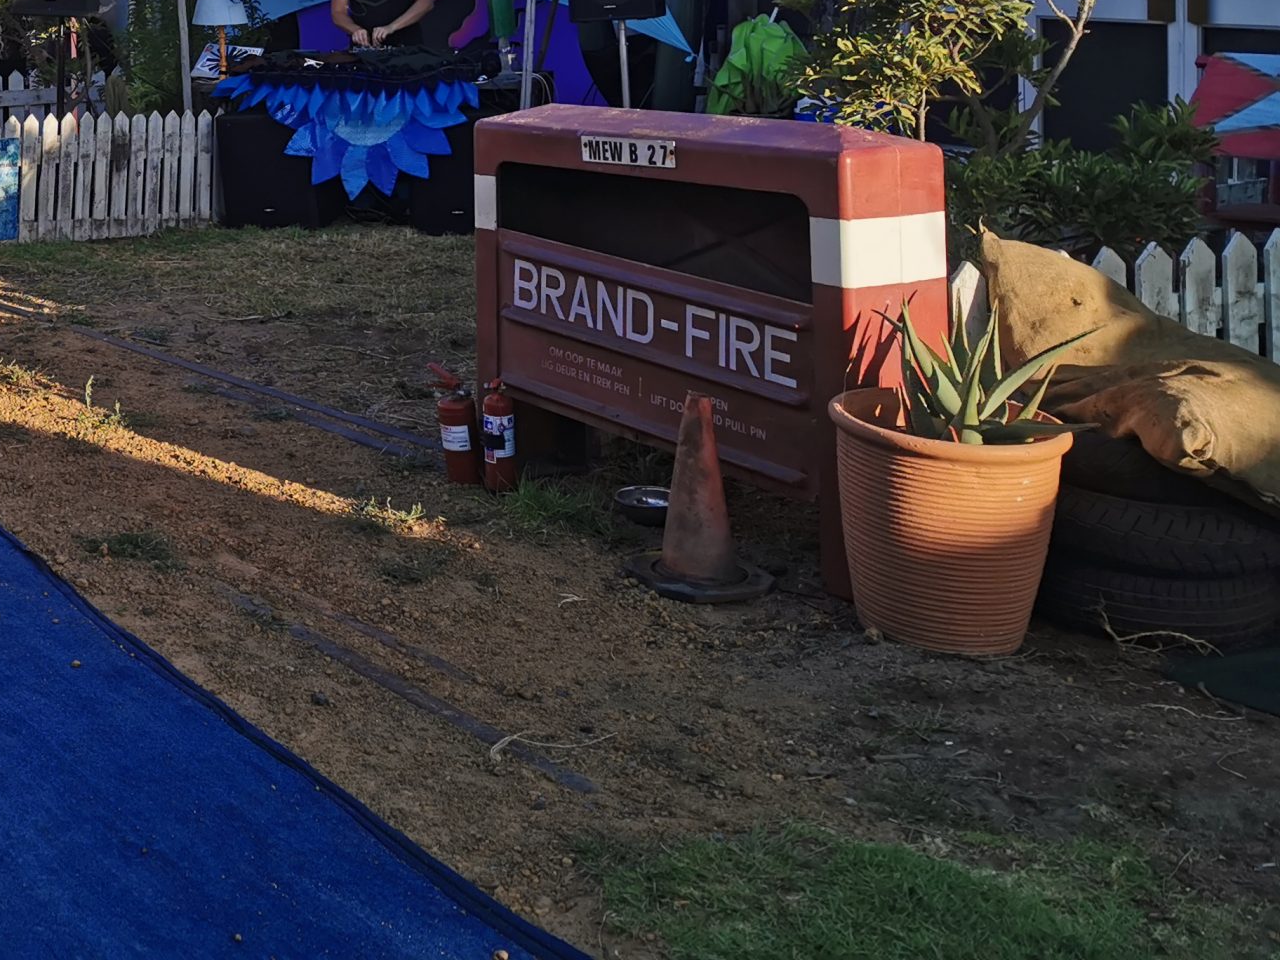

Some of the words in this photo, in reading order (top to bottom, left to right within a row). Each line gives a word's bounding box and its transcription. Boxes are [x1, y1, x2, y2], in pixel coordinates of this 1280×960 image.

[587, 139, 623, 162] MEW
[629, 142, 638, 163] B
[647, 144, 667, 165] 27
[513, 259, 798, 388] BRAND-FIRE
[549, 346, 563, 359] OM
[565, 351, 584, 366] OOP
[597, 361, 623, 377] MAAK
[556, 363, 577, 378] DEUR
[592, 374, 612, 390] TREK
[614, 382, 630, 395] PEN
[650, 393, 667, 407] LIFT
[725, 418, 747, 434] PULL
[750, 425, 767, 441] PIN
[710, 396, 728, 411] PEN
